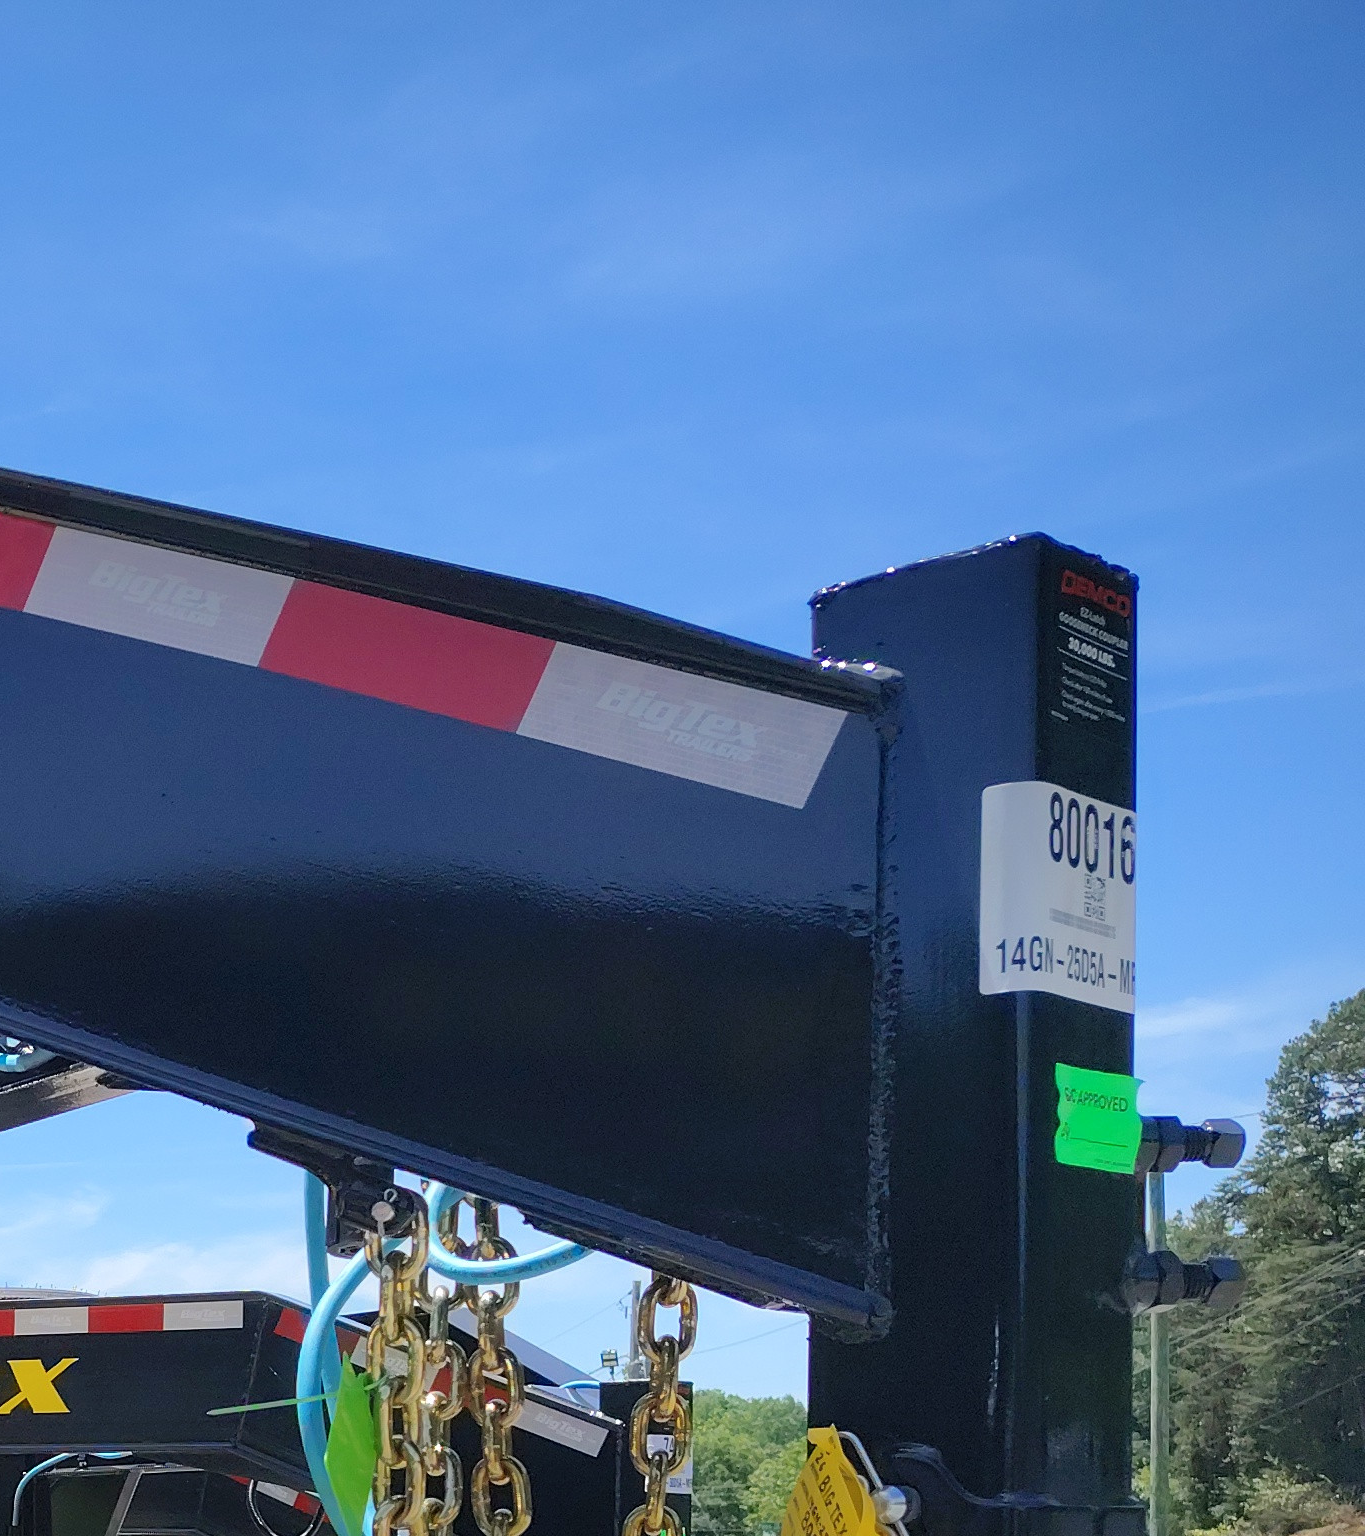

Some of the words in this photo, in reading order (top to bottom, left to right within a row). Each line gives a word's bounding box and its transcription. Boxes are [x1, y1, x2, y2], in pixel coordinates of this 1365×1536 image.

[1061, 569, 1130, 617] DEMCO
[595, 681, 769, 748] BigTex
[1048, 791, 1136, 885] 80016
[1076, 1090, 1129, 1112] APPROVED
